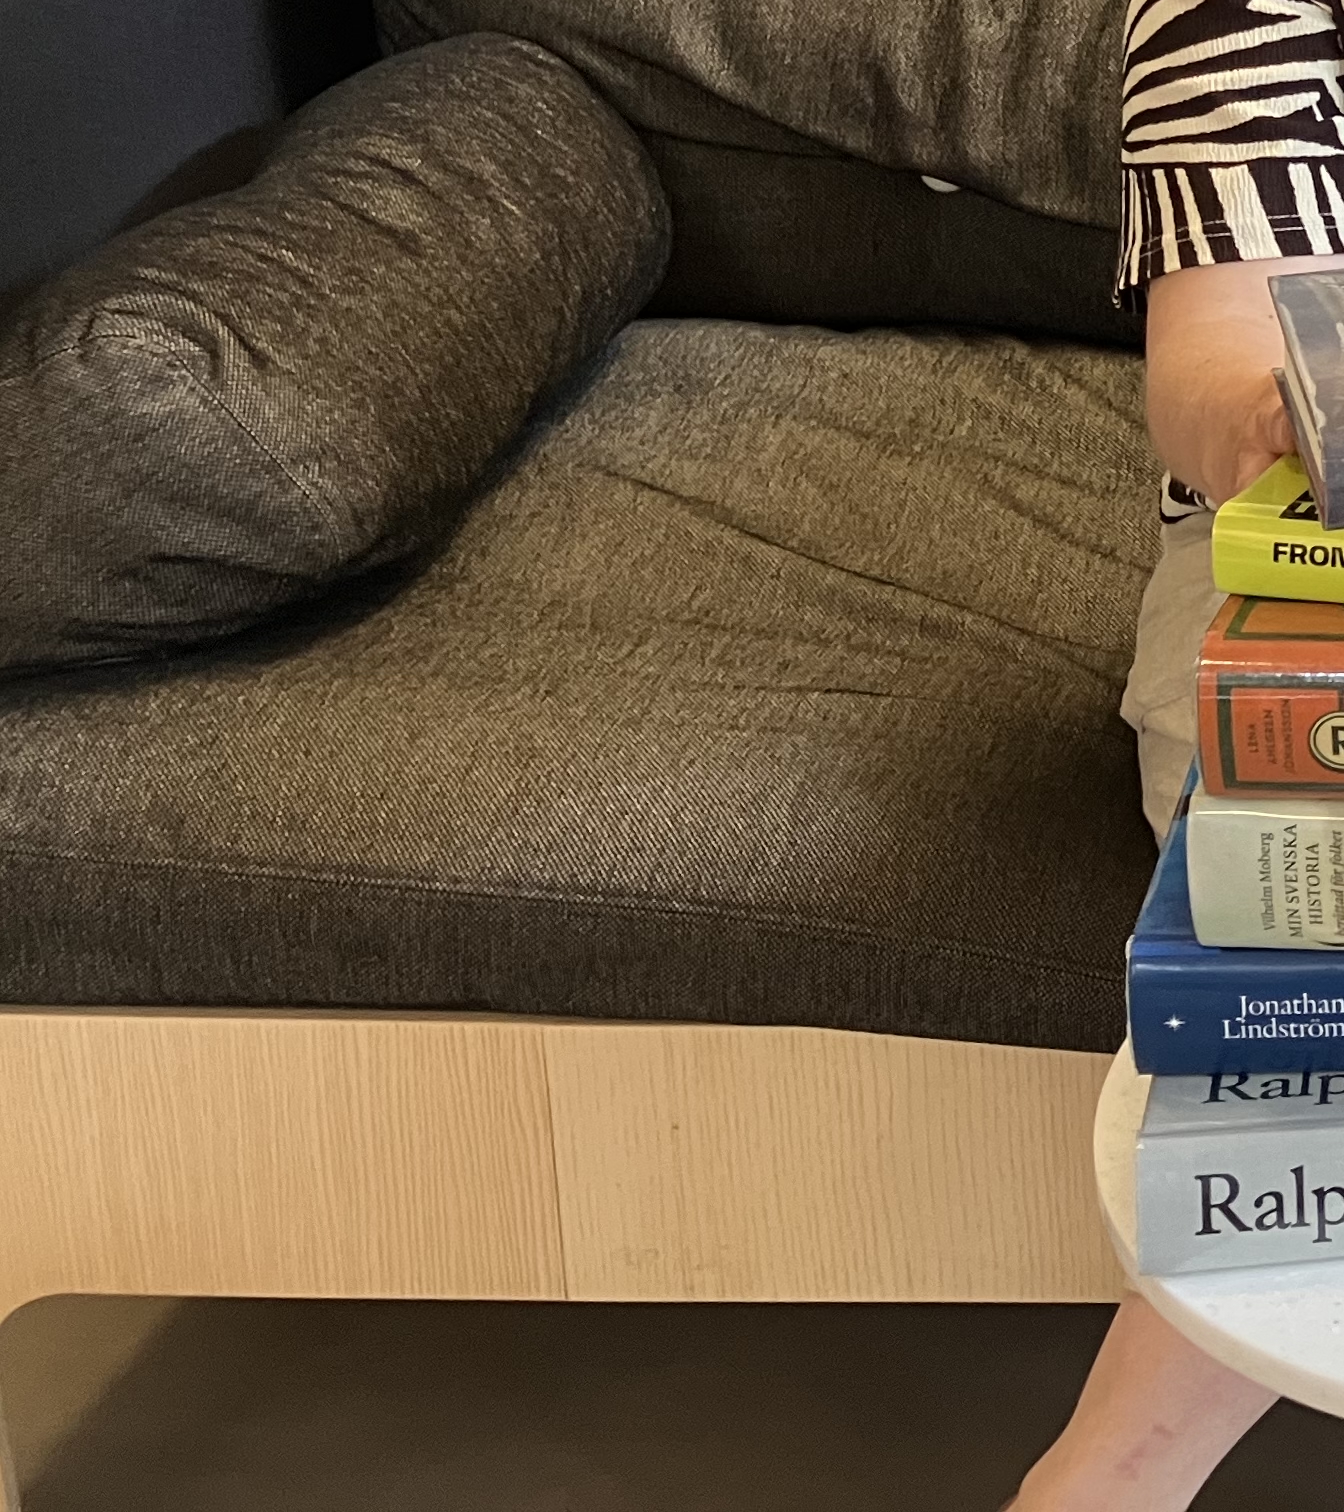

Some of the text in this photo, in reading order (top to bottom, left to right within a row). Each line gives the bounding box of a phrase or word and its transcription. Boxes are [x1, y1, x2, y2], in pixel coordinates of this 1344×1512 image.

[1247, 723, 1260, 754] LENA
[1258, 832, 1276, 931] Vilhelm Moberg
[1283, 823, 1303, 938] MIN SVENSKA
[1304, 842, 1323, 925] HISTORIA
